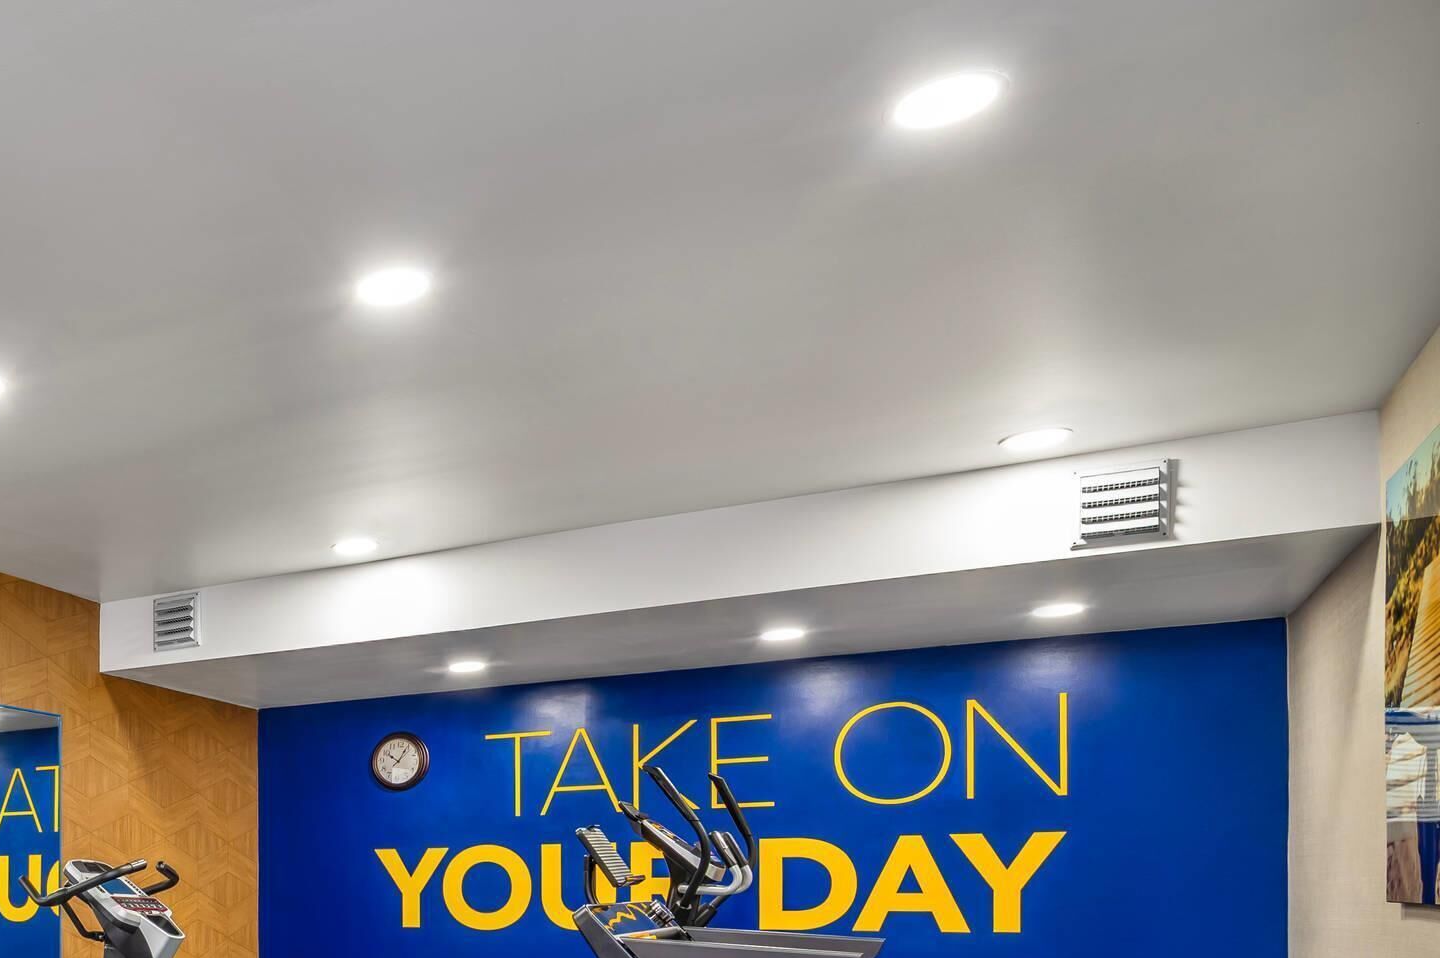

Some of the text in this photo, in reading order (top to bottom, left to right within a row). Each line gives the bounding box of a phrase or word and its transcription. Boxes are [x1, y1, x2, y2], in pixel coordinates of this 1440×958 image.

[485, 692, 1069, 817] TAKE ON
[758, 831, 1067, 933] DAY
